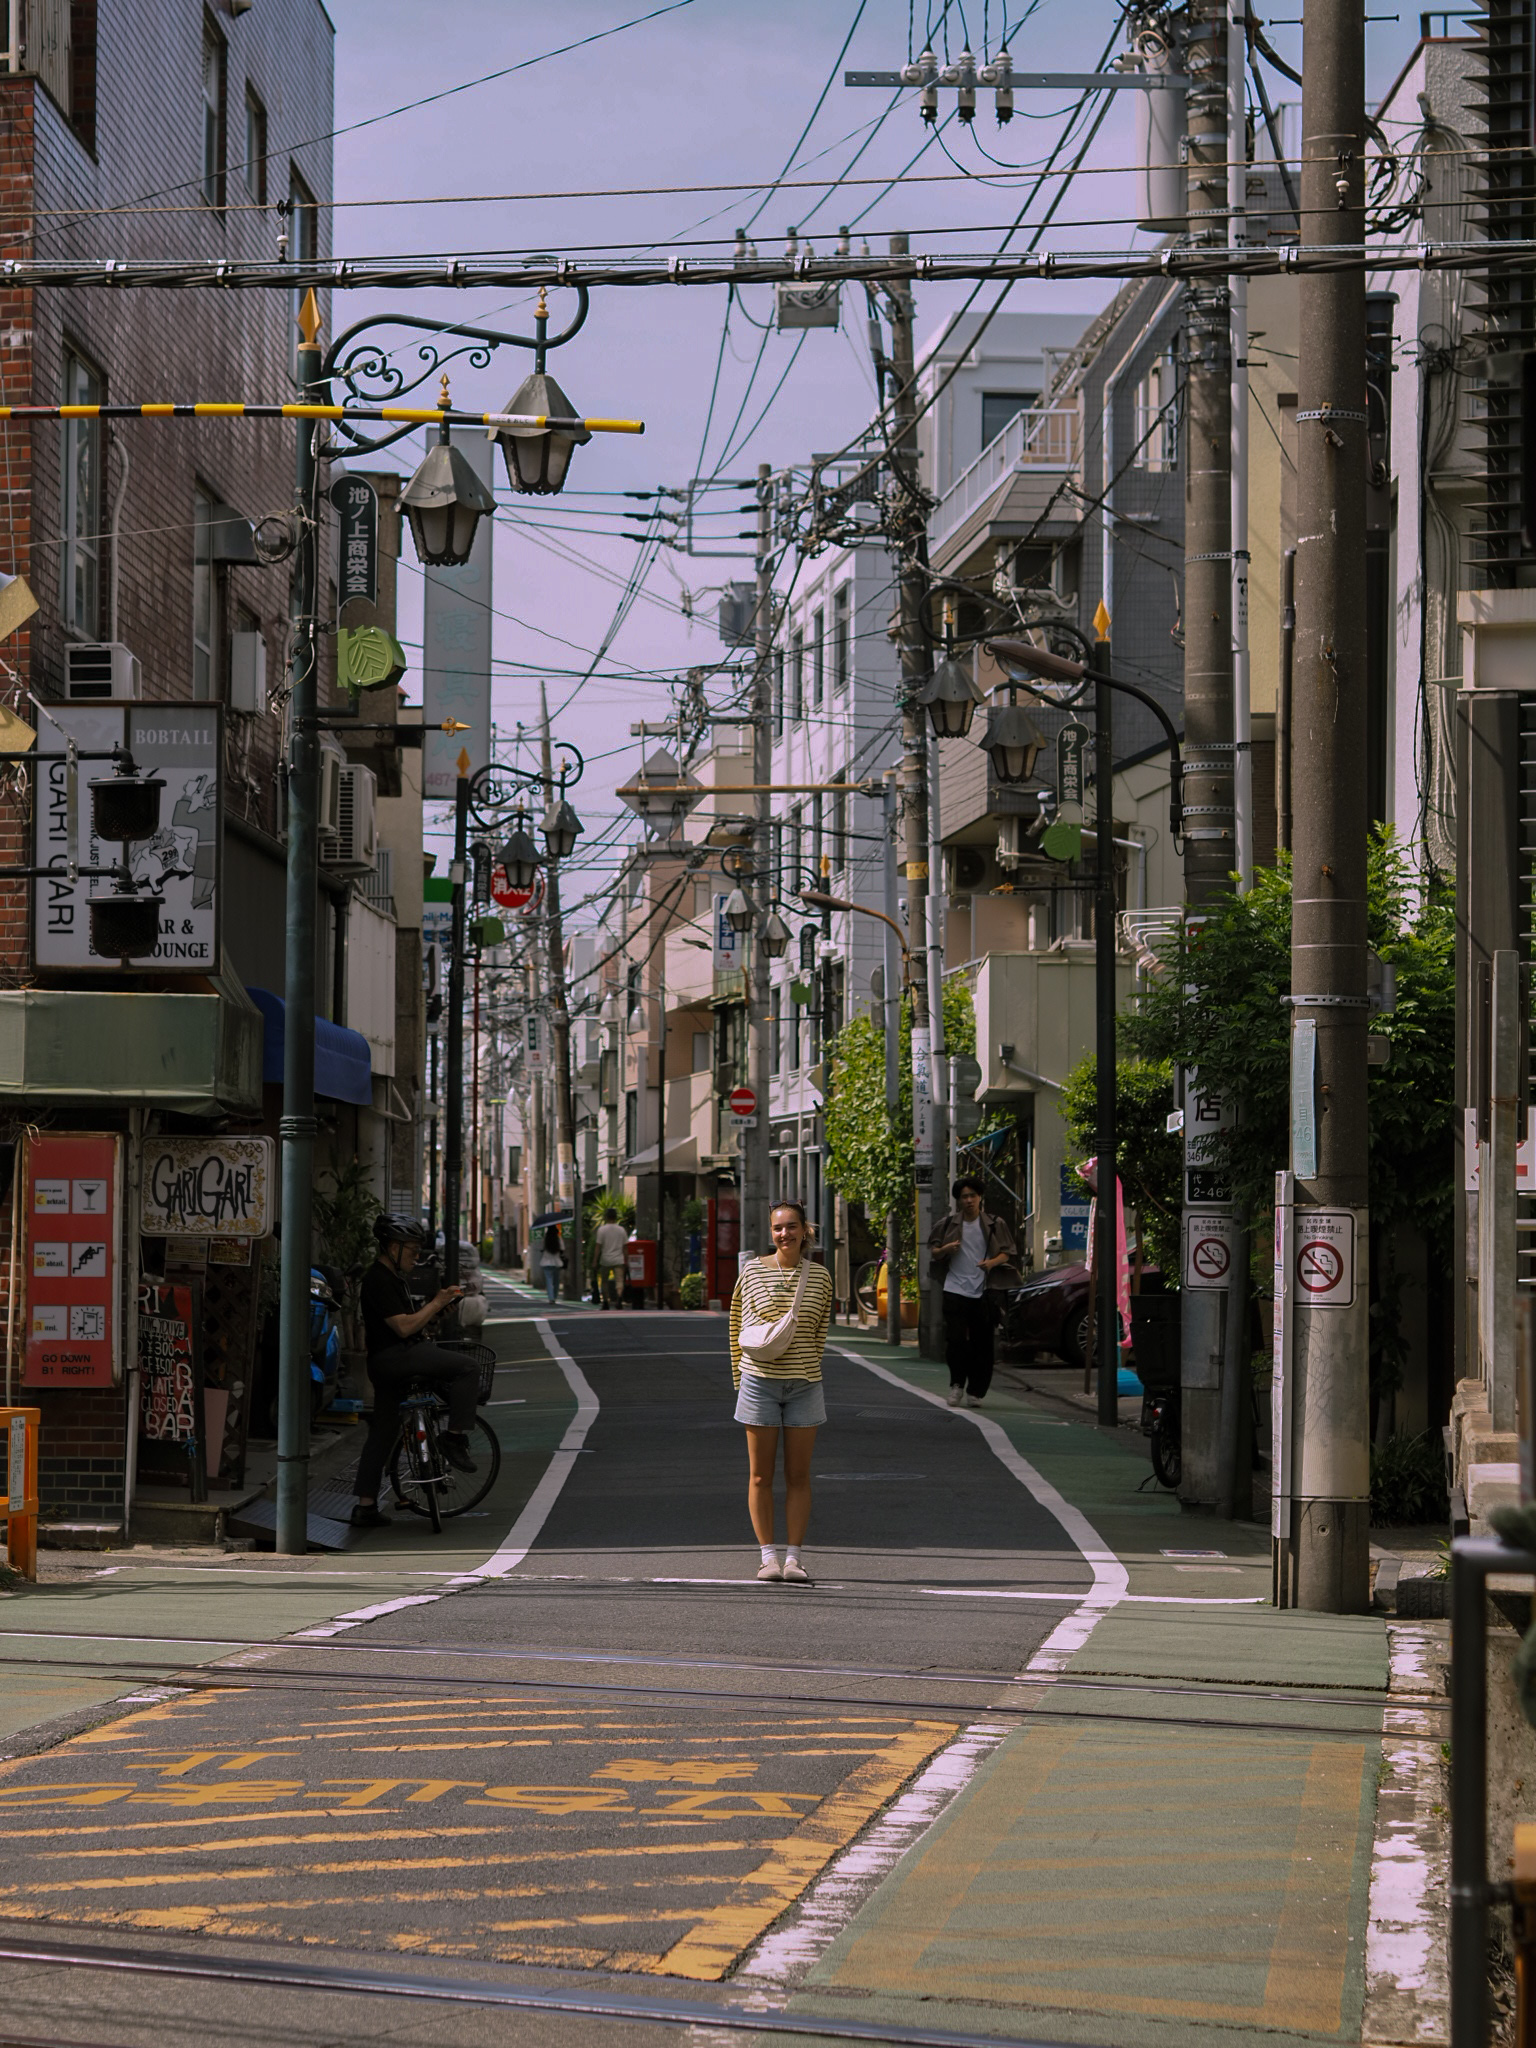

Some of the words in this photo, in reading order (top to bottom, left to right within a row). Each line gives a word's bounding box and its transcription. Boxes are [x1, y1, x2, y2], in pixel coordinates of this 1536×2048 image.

[346, 486, 370, 593] 池ノ上商栄会
[135, 729, 213, 746] BOBTAIL
[1062, 729, 1078, 800] 池ノ上商栄会
[181, 919, 194, 934] &
[151, 943, 209, 958] OUNGE
[1193, 1187, 1223, 1198] 2-46
[42, 1354, 57, 1363] GO
[60, 1354, 91, 1363] DOWN
[42, 1366, 54, 1375] B1
[62, 1366, 95, 1375] RIGHT!
[141, 1396, 178, 1414] CLOSED
